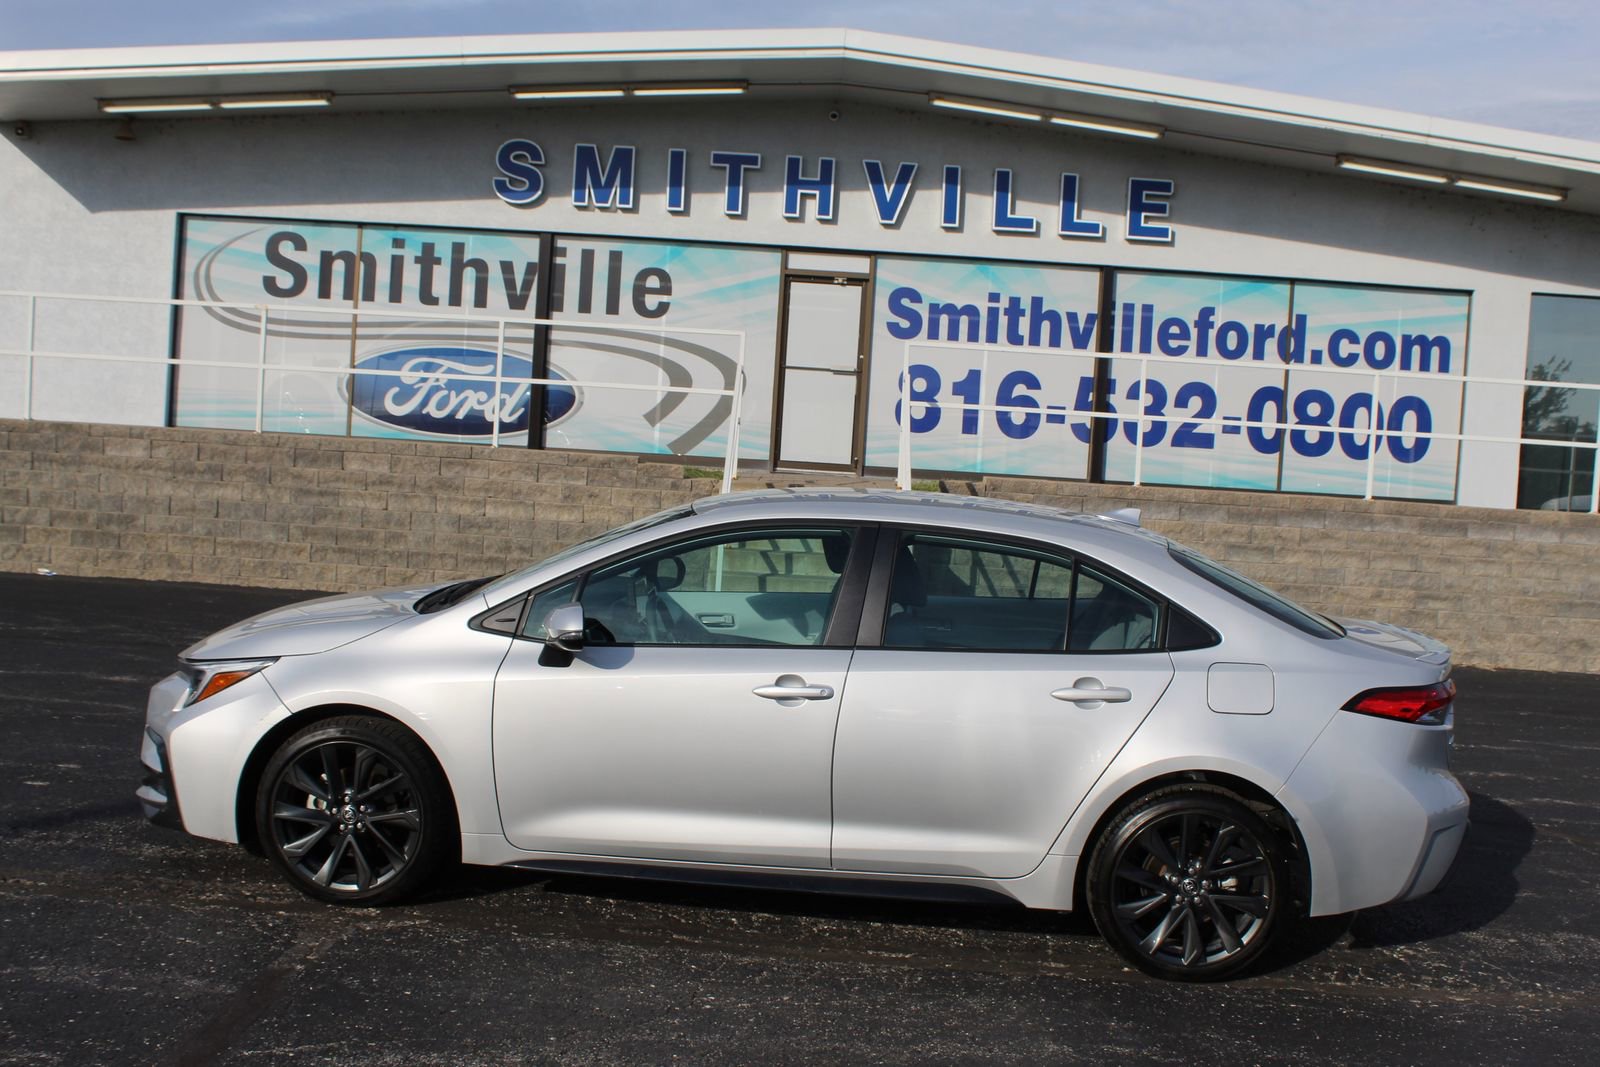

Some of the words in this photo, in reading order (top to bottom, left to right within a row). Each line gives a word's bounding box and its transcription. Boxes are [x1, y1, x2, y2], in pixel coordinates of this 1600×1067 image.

[493, 138, 1174, 244] SMITHVILLE
[262, 231, 673, 319] Smithville
[384, 356, 527, 423] Ford
[895, 364, 1433, 464] 816-532-0800
